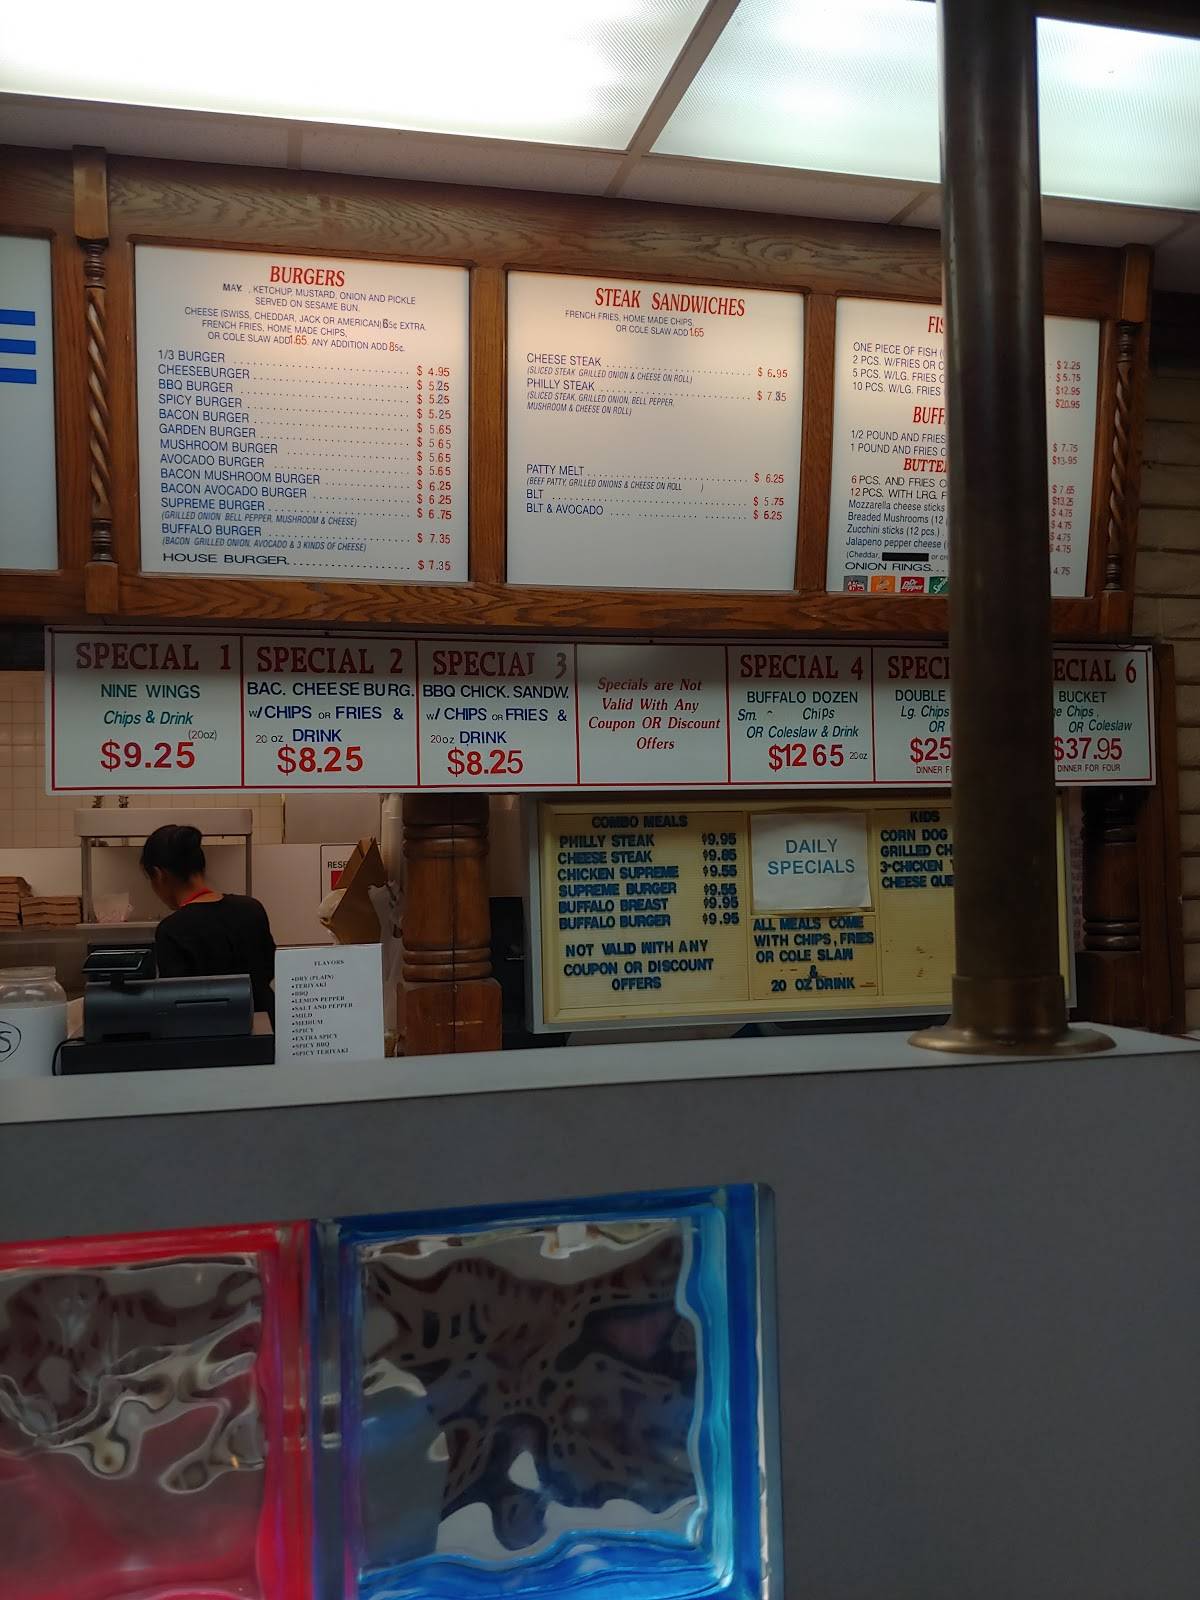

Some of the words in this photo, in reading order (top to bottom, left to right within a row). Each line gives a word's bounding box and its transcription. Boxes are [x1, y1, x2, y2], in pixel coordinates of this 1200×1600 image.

[270, 266, 345, 287] BURGERS
[255, 297, 287, 307] SERVED
[290, 300, 302, 308] ON
[305, 301, 338, 310] SESAME
[595, 287, 641, 308] STEAK
[652, 292, 745, 317] SANDWICHES
[566, 310, 596, 321] FRENCH
[623, 314, 646, 323] HOME
[648, 315, 669, 324] MADE
[158, 350, 175, 360] 1/3
[179, 351, 225, 362] BURGER
[853, 342, 872, 353] ONE
[875, 344, 901, 355] PIECE
[903, 346, 915, 355] OF
[918, 347, 937, 357] FISH
[527, 353, 566, 365] CHEESE
[570, 355, 601, 367] STEAK
[158, 364, 250, 379] CHEESEBURGER
[159, 379, 183, 391] BBQ
[187, 381, 233, 393] BURGER
[159, 394, 192, 405] SPICY
[196, 396, 242, 407] BURGER
[159, 409, 198, 420] BACON
[203, 411, 249, 423] BURGER
[159, 424, 206, 436] GARDEN
[210, 426, 256, 438] BURGER
[160, 439, 227, 451] MUSHROOM
[232, 442, 278, 454] BURGER
[160, 454, 214, 465] AVOCADO
[219, 456, 264, 468] BURGER
[161, 469, 200, 480] BACON
[204, 470, 271, 483] MUSHROOM
[275, 473, 320, 485] BURGER
[526, 464, 556, 475] PATTY
[559, 466, 584, 476] MELT
[161, 483, 200, 493] BACON
[204, 485, 258, 496] AVOCADO
[262, 487, 307, 498] BURGER
[527, 489, 544, 499] BLT
[161, 498, 214, 509] SUPREME
[219, 500, 265, 511] BURGER
[527, 504, 544, 514] BLT
[547, 504, 553, 514] &
[556, 505, 603, 516] AVOCADO
[848, 500, 891, 510] Mozzarella
[893, 502, 921, 511] cheese
[924, 503, 945, 512] sticks
[848, 512, 881, 521] Breaded
[884, 513, 929, 523] Mushrooms
[162, 524, 212, 535] BUFFALO
[216, 525, 261, 536] BURGER
[847, 524, 880, 534] Zucchini
[882, 525, 904, 535] sticks
[846, 537, 882, 546] Jalapeno
[884, 539, 911, 549] pepper
[914, 540, 941, 549] cheese
[163, 553, 218, 563] HOUSE
[845, 562, 887, 571] ONION
[76, 642, 199, 670] SPECIAL
[220, 644, 231, 670] 1
[257, 647, 374, 674] SPECIAL
[390, 649, 403, 674] 2
[741, 655, 839, 679] SPECIAL
[851, 657, 863, 680] 4
[101, 684, 137, 698] NINE
[146, 685, 200, 699] WINGS
[423, 685, 456, 697] BBQ
[461, 686, 510, 698] CHICK.
[513, 686, 569, 698] SANDW.
[598, 677, 648, 693] Specials
[655, 681, 674, 691] are
[680, 679, 703, 691] Not
[747, 691, 806, 703] BUFFALO
[813, 691, 858, 703] DOZEN
[896, 690, 946, 701] DOUBLE
[1059, 691, 1107, 703] BUCKET
[602, 698, 633, 710] Valid
[640, 698, 668, 711] With
[674, 699, 699, 713] Any
[104, 711, 141, 727] Chips
[145, 710, 155, 724] &
[160, 712, 194, 725] Drink
[589, 716, 635, 732] Coupon
[642, 717, 662, 729] OR
[668, 716, 720, 729] Discount
[747, 726, 763, 738] OR
[769, 726, 818, 738] Coleslaw
[821, 726, 828, 737] &
[833, 726, 859, 737] Drink
[1069, 721, 1084, 733] OR
[1089, 719, 1133, 731] Coleslaw
[188, 730, 218, 741] (20oz)
[255, 735, 267, 743] 20
[293, 729, 342, 742] DRINK
[636, 737, 675, 750] Offers
[1054, 736, 1122, 762] $37.95
[100, 739, 195, 772] $9.25
[277, 744, 363, 776] $8.25
[448, 747, 524, 777] $8.25
[1058, 764, 1082, 773] DINNER
[1085, 764, 1099, 772] FOR
[1103, 763, 1121, 772] FOUR
[592, 816, 639, 828] COMBO
[644, 816, 688, 827] MEALS
[910, 811, 940, 822] KIDS
[560, 835, 606, 848] PHILLY
[612, 834, 655, 847] STEAK
[881, 830, 916, 841] CORN
[922, 829, 948, 840] DOG
[786, 839, 838, 853] DAILY
[768, 859, 855, 874] SPECIALS
[559, 900, 614, 913] BUFFALO
[620, 898, 668, 911] BREAST
[560, 916, 615, 930] BUFFALO
[620, 915, 671, 928] BURGER
[753, 918, 776, 931] ALL
[780, 917, 821, 930] MEALS
[829, 916, 864, 928] COME
[566, 944, 594, 957] NOT
[602, 942, 636, 955] VALID
[642, 941, 673, 954] WITH
[679, 940, 708, 953] ANY
[756, 951, 774, 963] OR
[779, 950, 812, 961] COLE
[818, 948, 853, 961] SLAW
[564, 962, 617, 976] COUPON
[625, 962, 642, 974] OR
[648, 959, 714, 972] DISCOUNT
[612, 977, 662, 990] OFFERS
